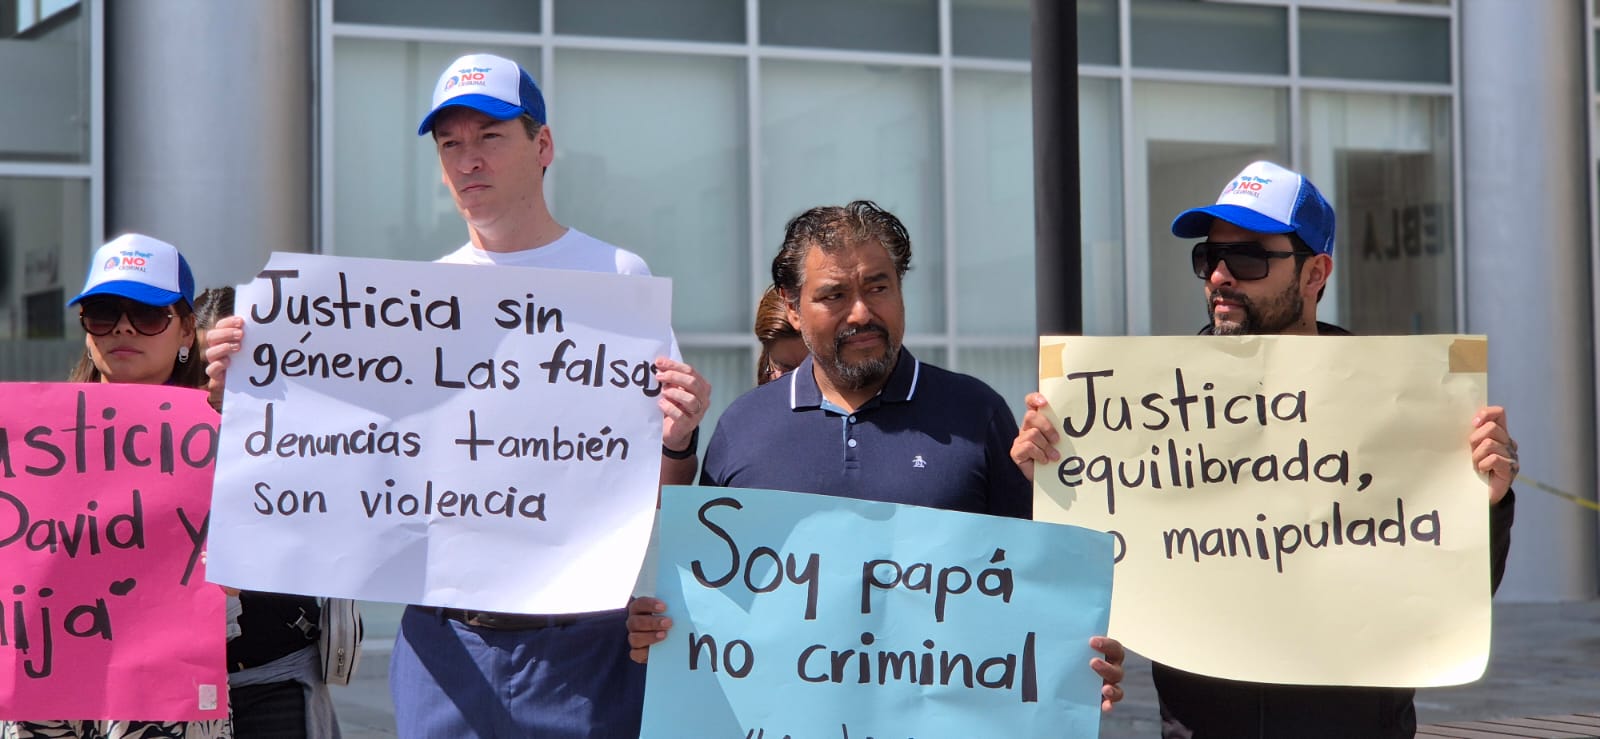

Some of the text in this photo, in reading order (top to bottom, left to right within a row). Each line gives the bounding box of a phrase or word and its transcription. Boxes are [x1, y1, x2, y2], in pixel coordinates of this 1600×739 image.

[461, 73, 485, 81] NO
[1239, 182, 1262, 190] NO
[122, 257, 145, 266] NO
[252, 270, 564, 335] Justicia sin
[249, 332, 414, 387] género.
[435, 346, 520, 390] Las
[245, 402, 630, 461] denuncias también
[1063, 367, 1307, 438] Justicia
[360, 479, 547, 522] violencia
[1057, 438, 1373, 515] equilibrada,
[176, 507, 210, 586] y
[690, 497, 1014, 623] Soy papá
[1163, 497, 1441, 573] manipulada
[0, 584, 112, 678] ija
[688, 631, 1039, 703] no criminal
